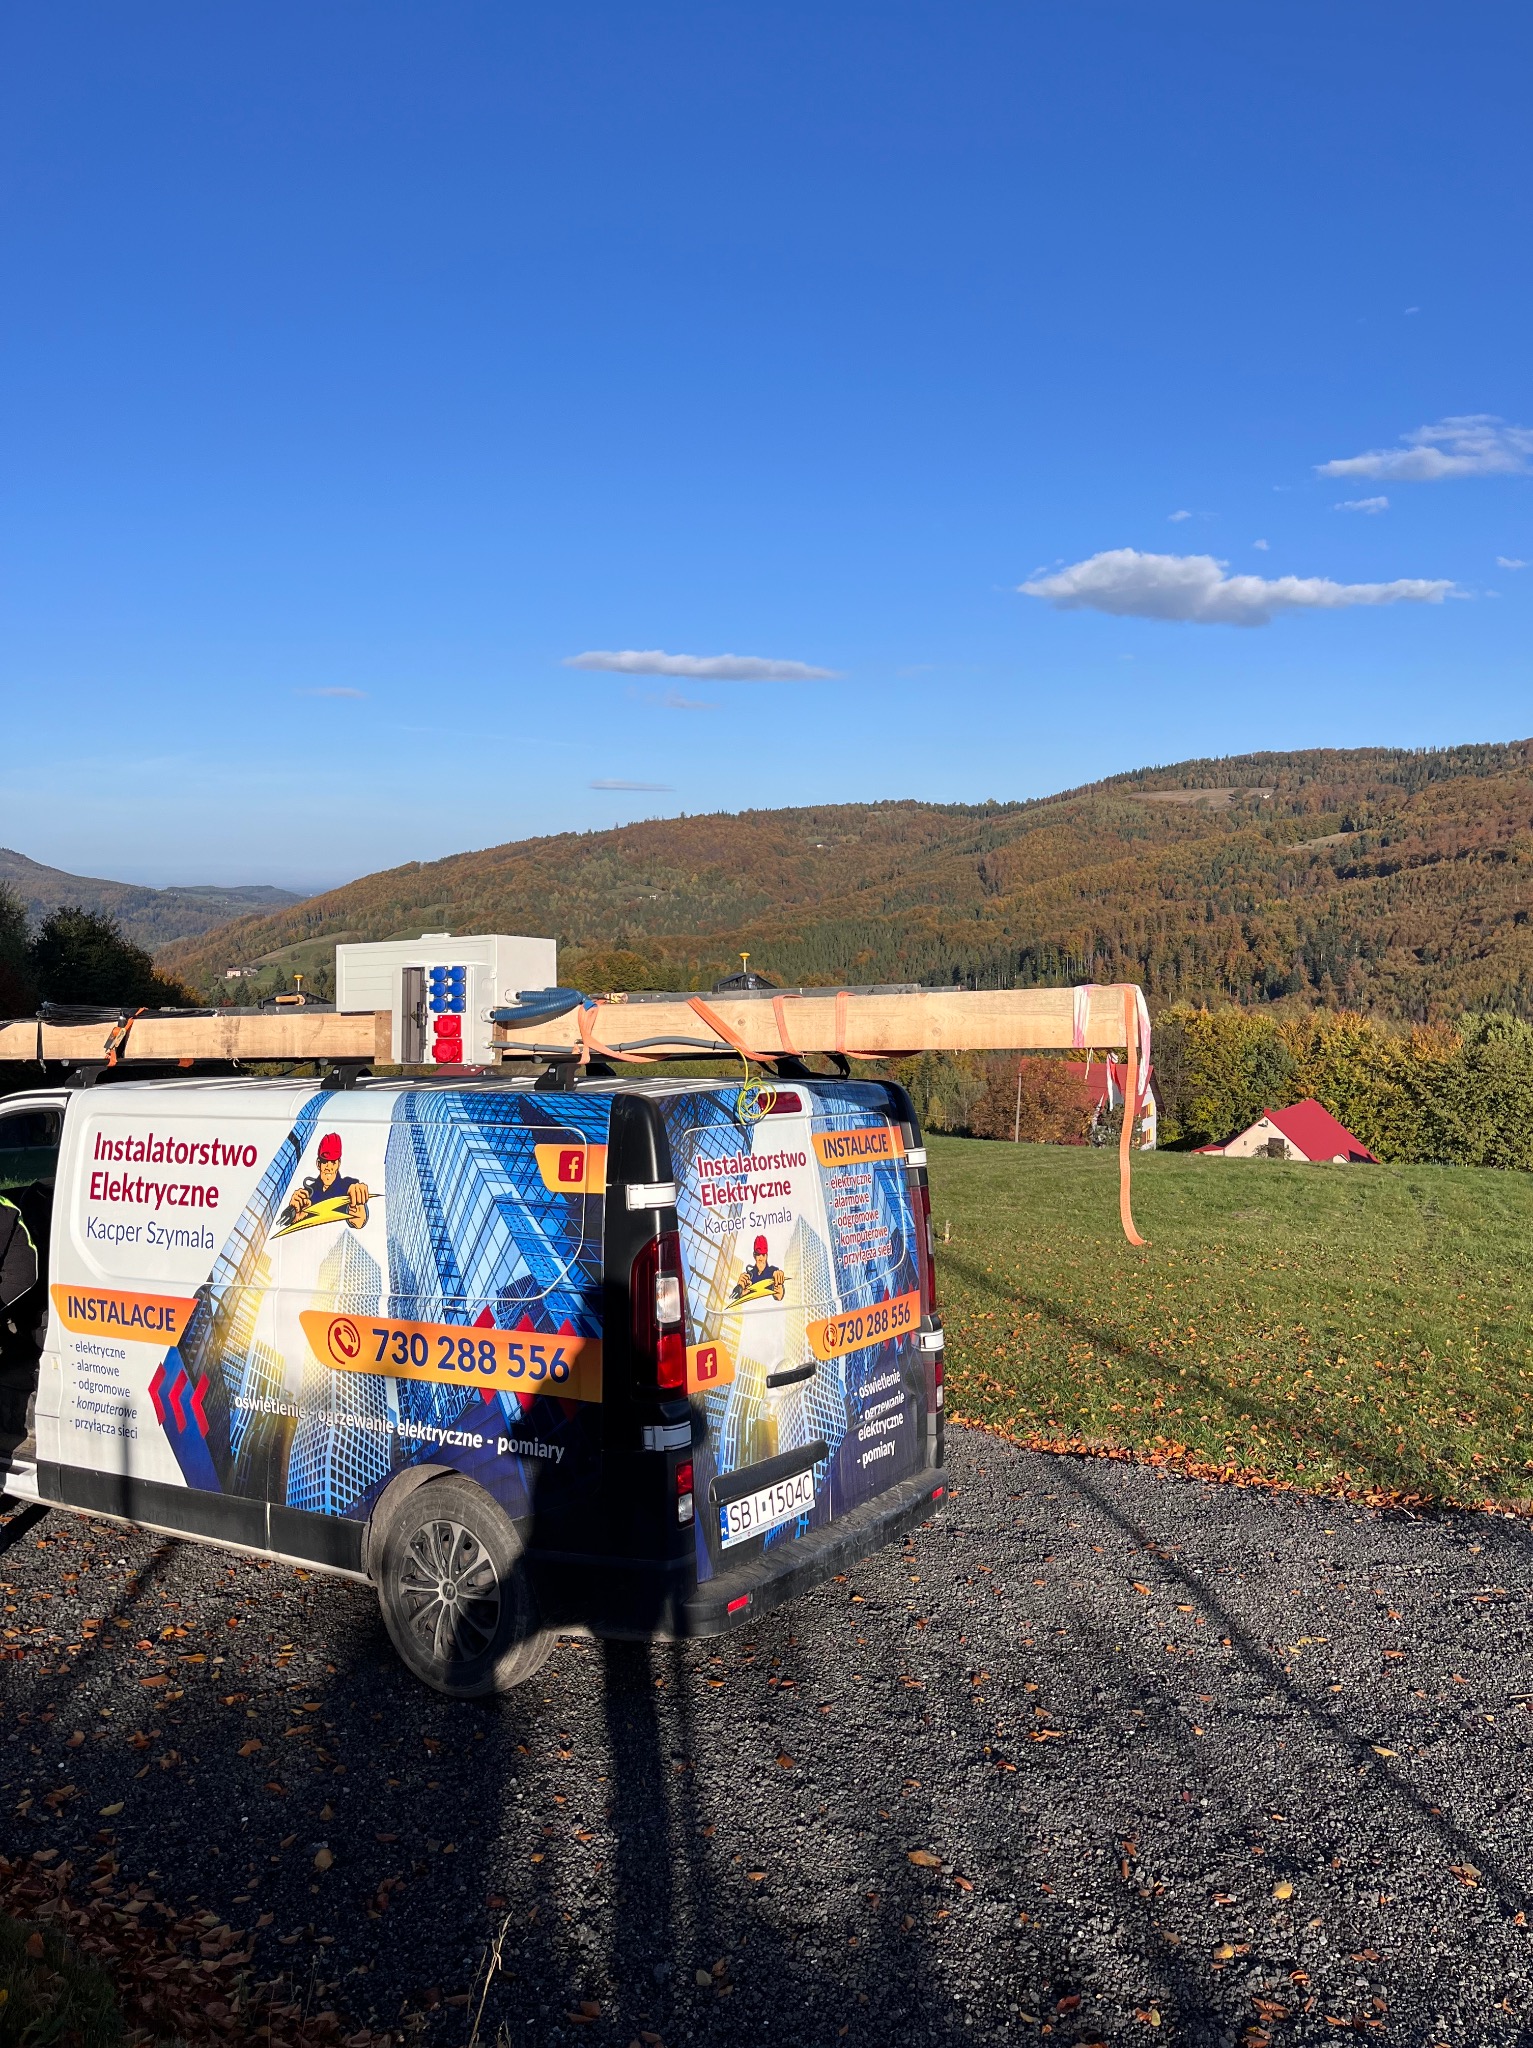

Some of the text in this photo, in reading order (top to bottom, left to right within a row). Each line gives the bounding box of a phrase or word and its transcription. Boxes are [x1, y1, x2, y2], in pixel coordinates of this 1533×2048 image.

[94, 1132, 258, 1168] Instalatorstwo
[823, 1133, 889, 1159] INSTALACJE
[697, 1149, 807, 1178] Instalatorstwo
[89, 1171, 219, 1211] Elektryczne
[701, 1180, 792, 1207] Elektryczne
[830, 1173, 872, 1189] elektryczne
[834, 1192, 870, 1208] alarmowe
[704, 1206, 792, 1235] Kacper Szymala
[837, 1209, 880, 1228] odgromowe
[87, 1216, 214, 1250] Kacper Szymala
[840, 1226, 889, 1246] komputerowe
[843, 1240, 893, 1267] przyłącza sieci
[68, 1295, 176, 1332] INSTALACJE
[838, 1301, 911, 1347] 730 288 556
[75, 1341, 126, 1359] elektryczne
[372, 1328, 570, 1384] 730 288 556
[77, 1360, 120, 1377] alarmowe
[78, 1378, 131, 1398] odgromowe
[858, 1368, 901, 1398] oświetlenie
[76, 1396, 138, 1419] komputerowe
[75, 1416, 138, 1439] przyłącza sieci
[234, 1394, 565, 1464] oświetlenie ogrzewanie elektryczne pomiary
[858, 1412, 904, 1441] elektryczne
[862, 1440, 896, 1469] pomiary
[729, 1474, 811, 1533] SBI 1504C
[721, 1527, 728, 1536] PL
